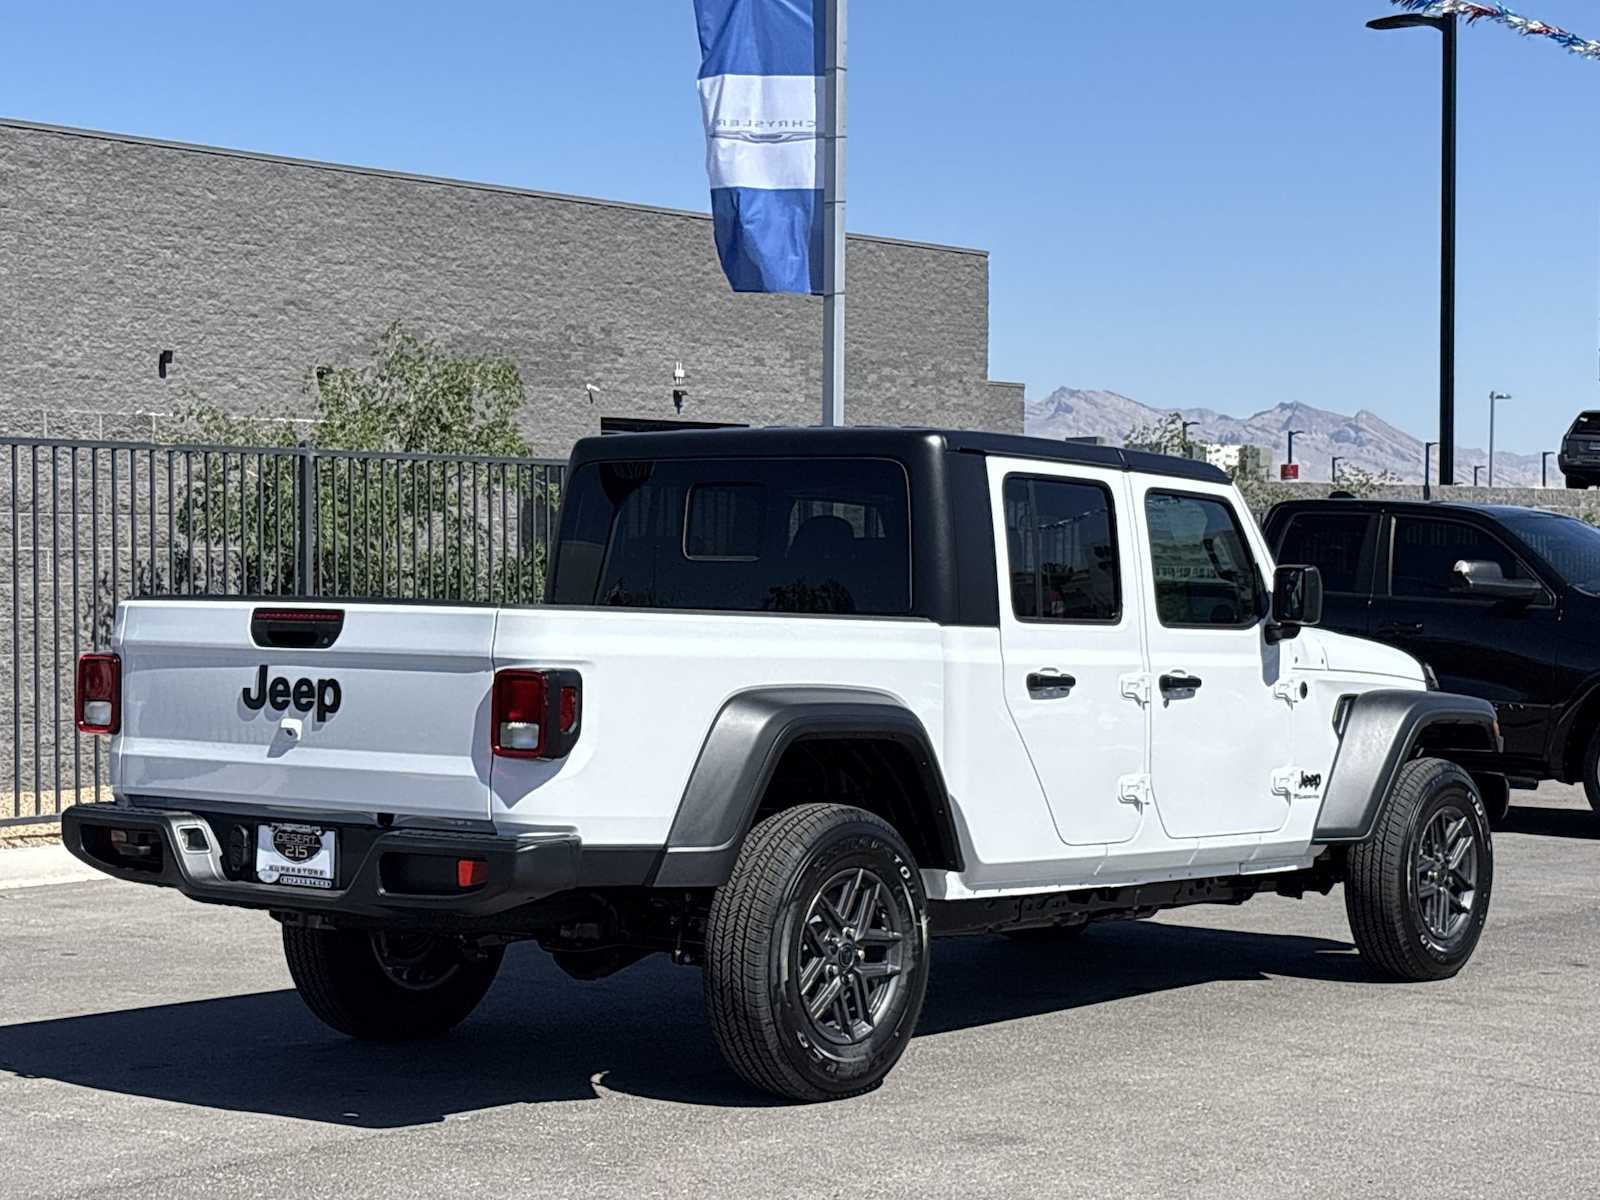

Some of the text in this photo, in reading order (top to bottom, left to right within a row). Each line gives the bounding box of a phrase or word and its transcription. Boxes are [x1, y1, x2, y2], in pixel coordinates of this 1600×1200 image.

[242, 664, 342, 722] Jeep
[1299, 770, 1321, 791] Jeep
[277, 833, 317, 845] DESERT
[285, 845, 308, 858] 215
